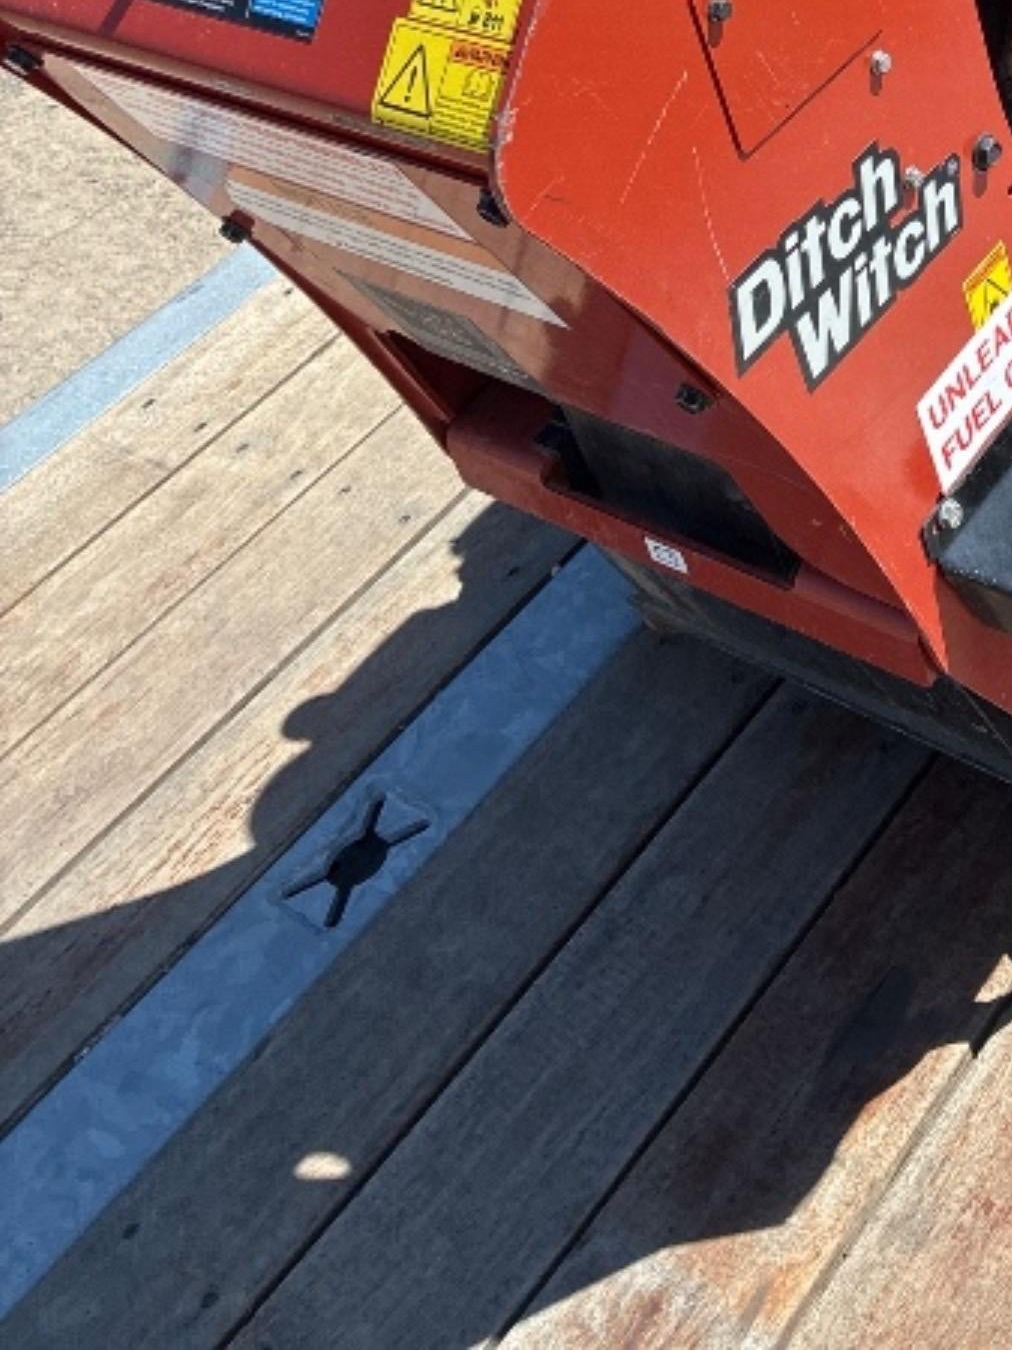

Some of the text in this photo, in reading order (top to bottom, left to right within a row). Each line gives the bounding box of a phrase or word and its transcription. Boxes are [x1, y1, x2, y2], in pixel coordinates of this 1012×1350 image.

[737, 156, 898, 361] Ditch
[796, 179, 959, 379] Witch
[941, 390, 1003, 470] FUEL
